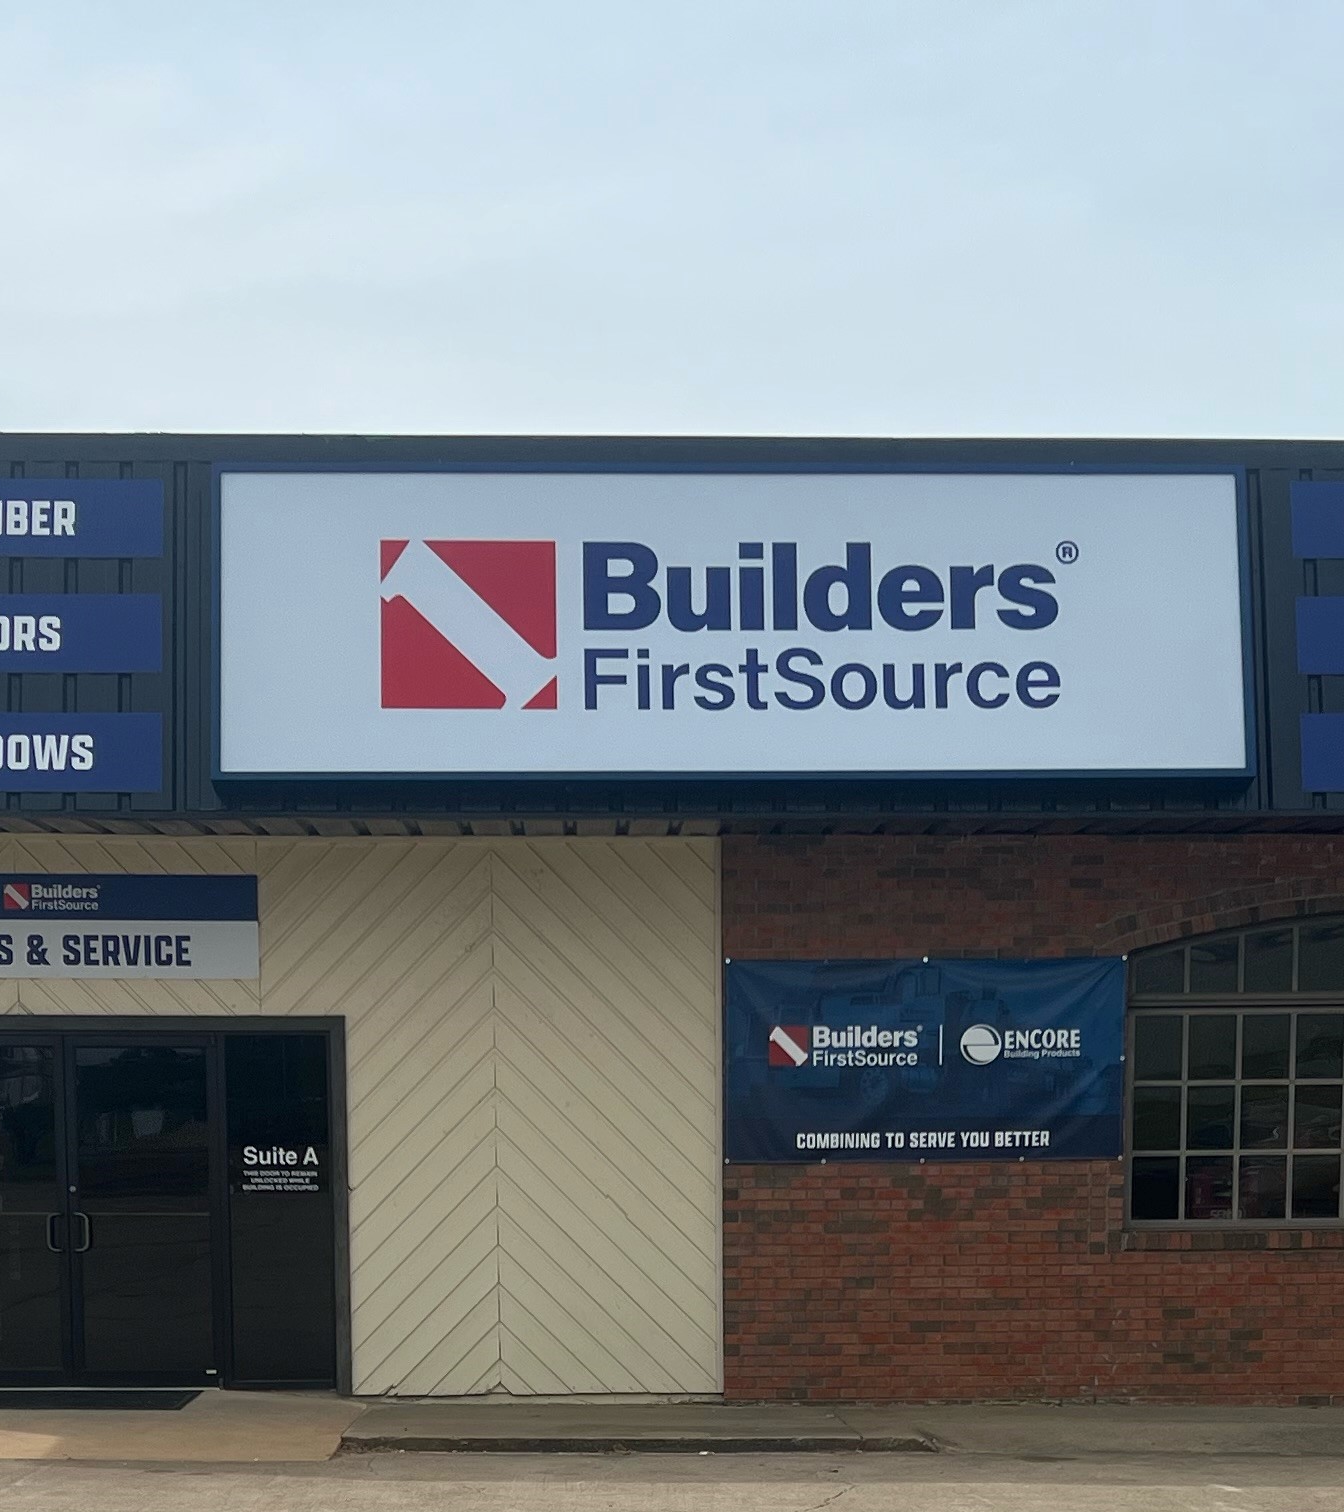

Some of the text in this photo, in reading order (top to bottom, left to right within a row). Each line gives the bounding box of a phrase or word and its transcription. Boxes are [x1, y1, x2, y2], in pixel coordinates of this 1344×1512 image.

[583, 647, 1062, 712] FirstSource
[31, 900, 99, 911] FirstSource
[26, 934, 52, 967] &
[62, 934, 192, 967] SERVICE
[1004, 1028, 1081, 1049] ENCORE
[812, 1050, 918, 1067] FirstSource
[1004, 1048, 1081, 1060] Building Products
[796, 1130, 1050, 1149] COMBINING TO SERVE YOU BETTER
[243, 1146, 319, 1166] Suite A
